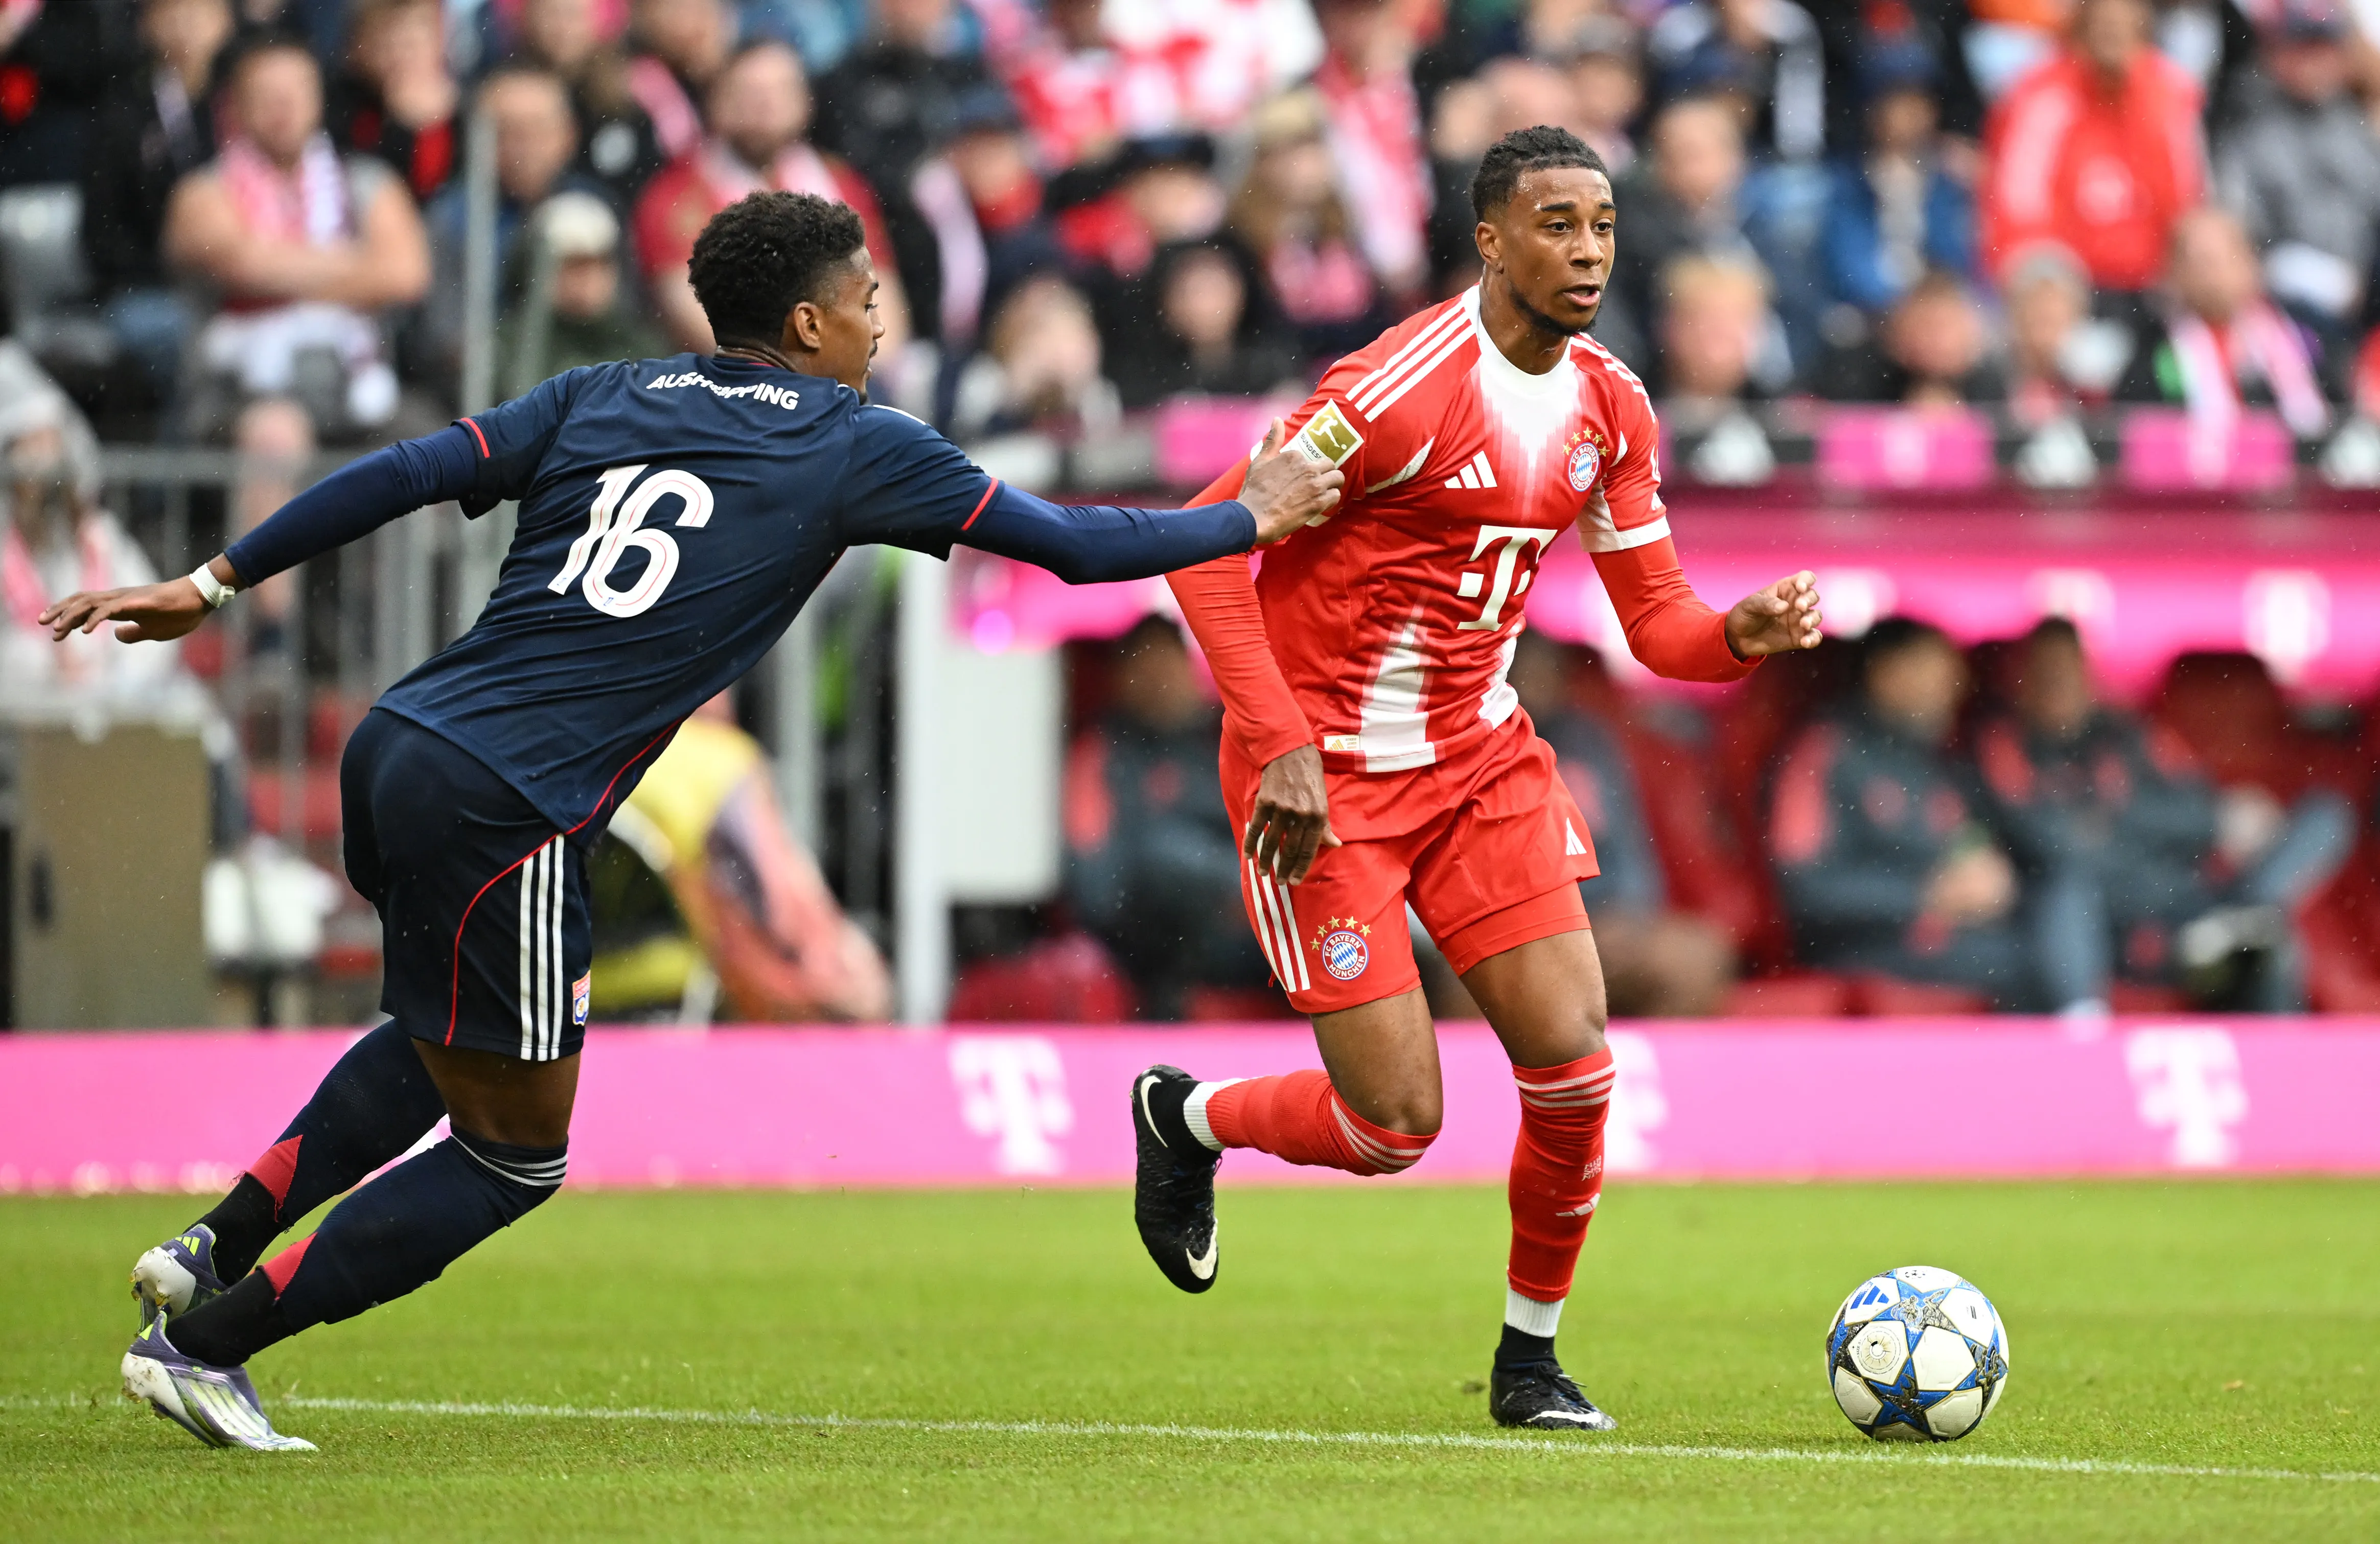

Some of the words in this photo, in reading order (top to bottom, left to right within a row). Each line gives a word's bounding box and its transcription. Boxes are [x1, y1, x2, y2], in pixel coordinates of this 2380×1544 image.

[1572, 453, 1579, 464] FC
[1579, 446, 1597, 463] BAYERN
[548, 464, 714, 618] 16
[1457, 525, 1558, 632] T
[1325, 945, 1331, 956] FC
[1329, 934, 1361, 949] BAYERN
[1329, 955, 1365, 977] MÜNCHEN
